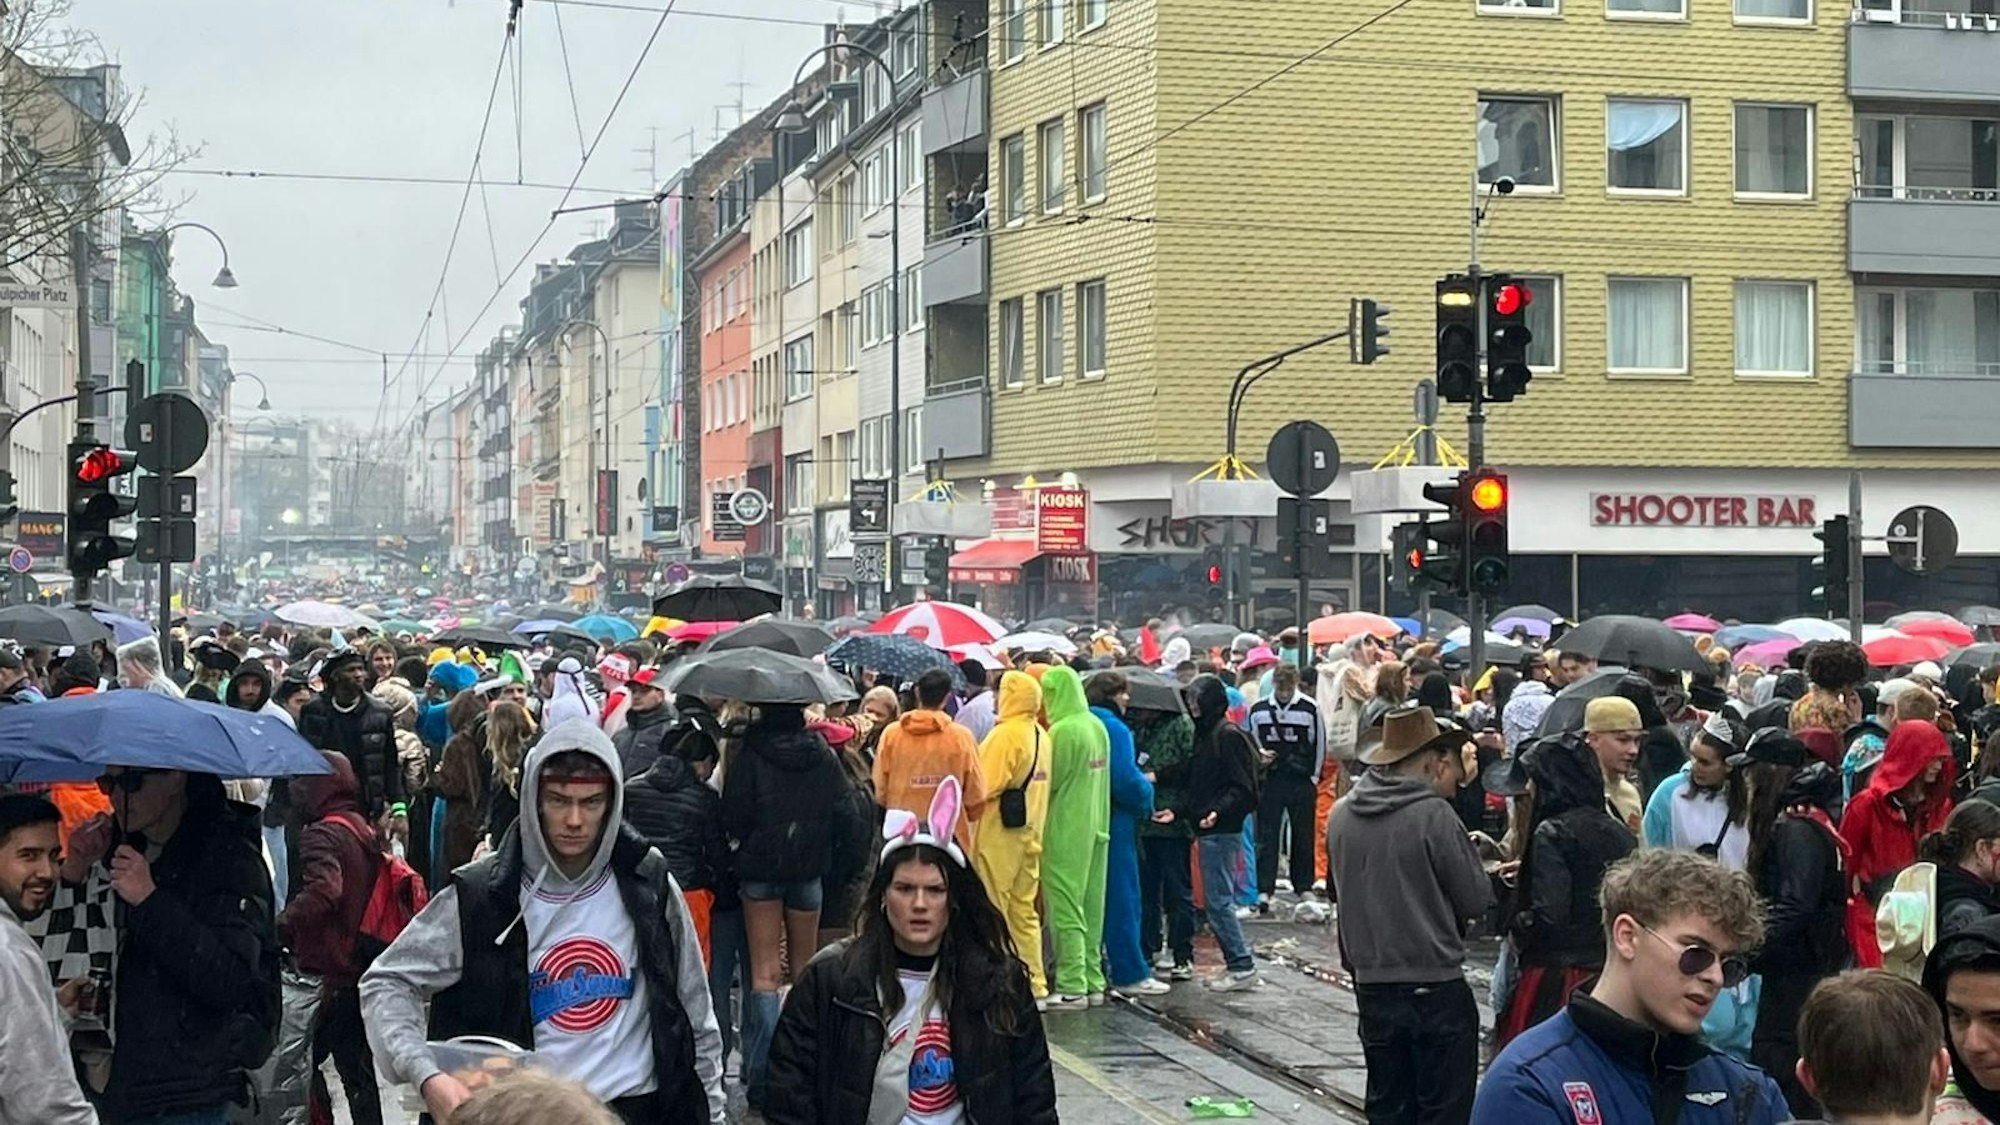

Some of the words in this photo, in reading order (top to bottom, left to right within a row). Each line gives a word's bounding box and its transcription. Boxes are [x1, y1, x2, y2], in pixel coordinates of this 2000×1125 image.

[0, 286, 40, 302] ülpicher
[43, 287, 67, 302] Platz
[120, 471, 131, 496] SAL
[1041, 493, 1085, 508] KIOSK
[1595, 494, 1748, 525] SHOOTER
[1757, 497, 1816, 527] BAR
[1052, 556, 1090, 581] KIOSK
